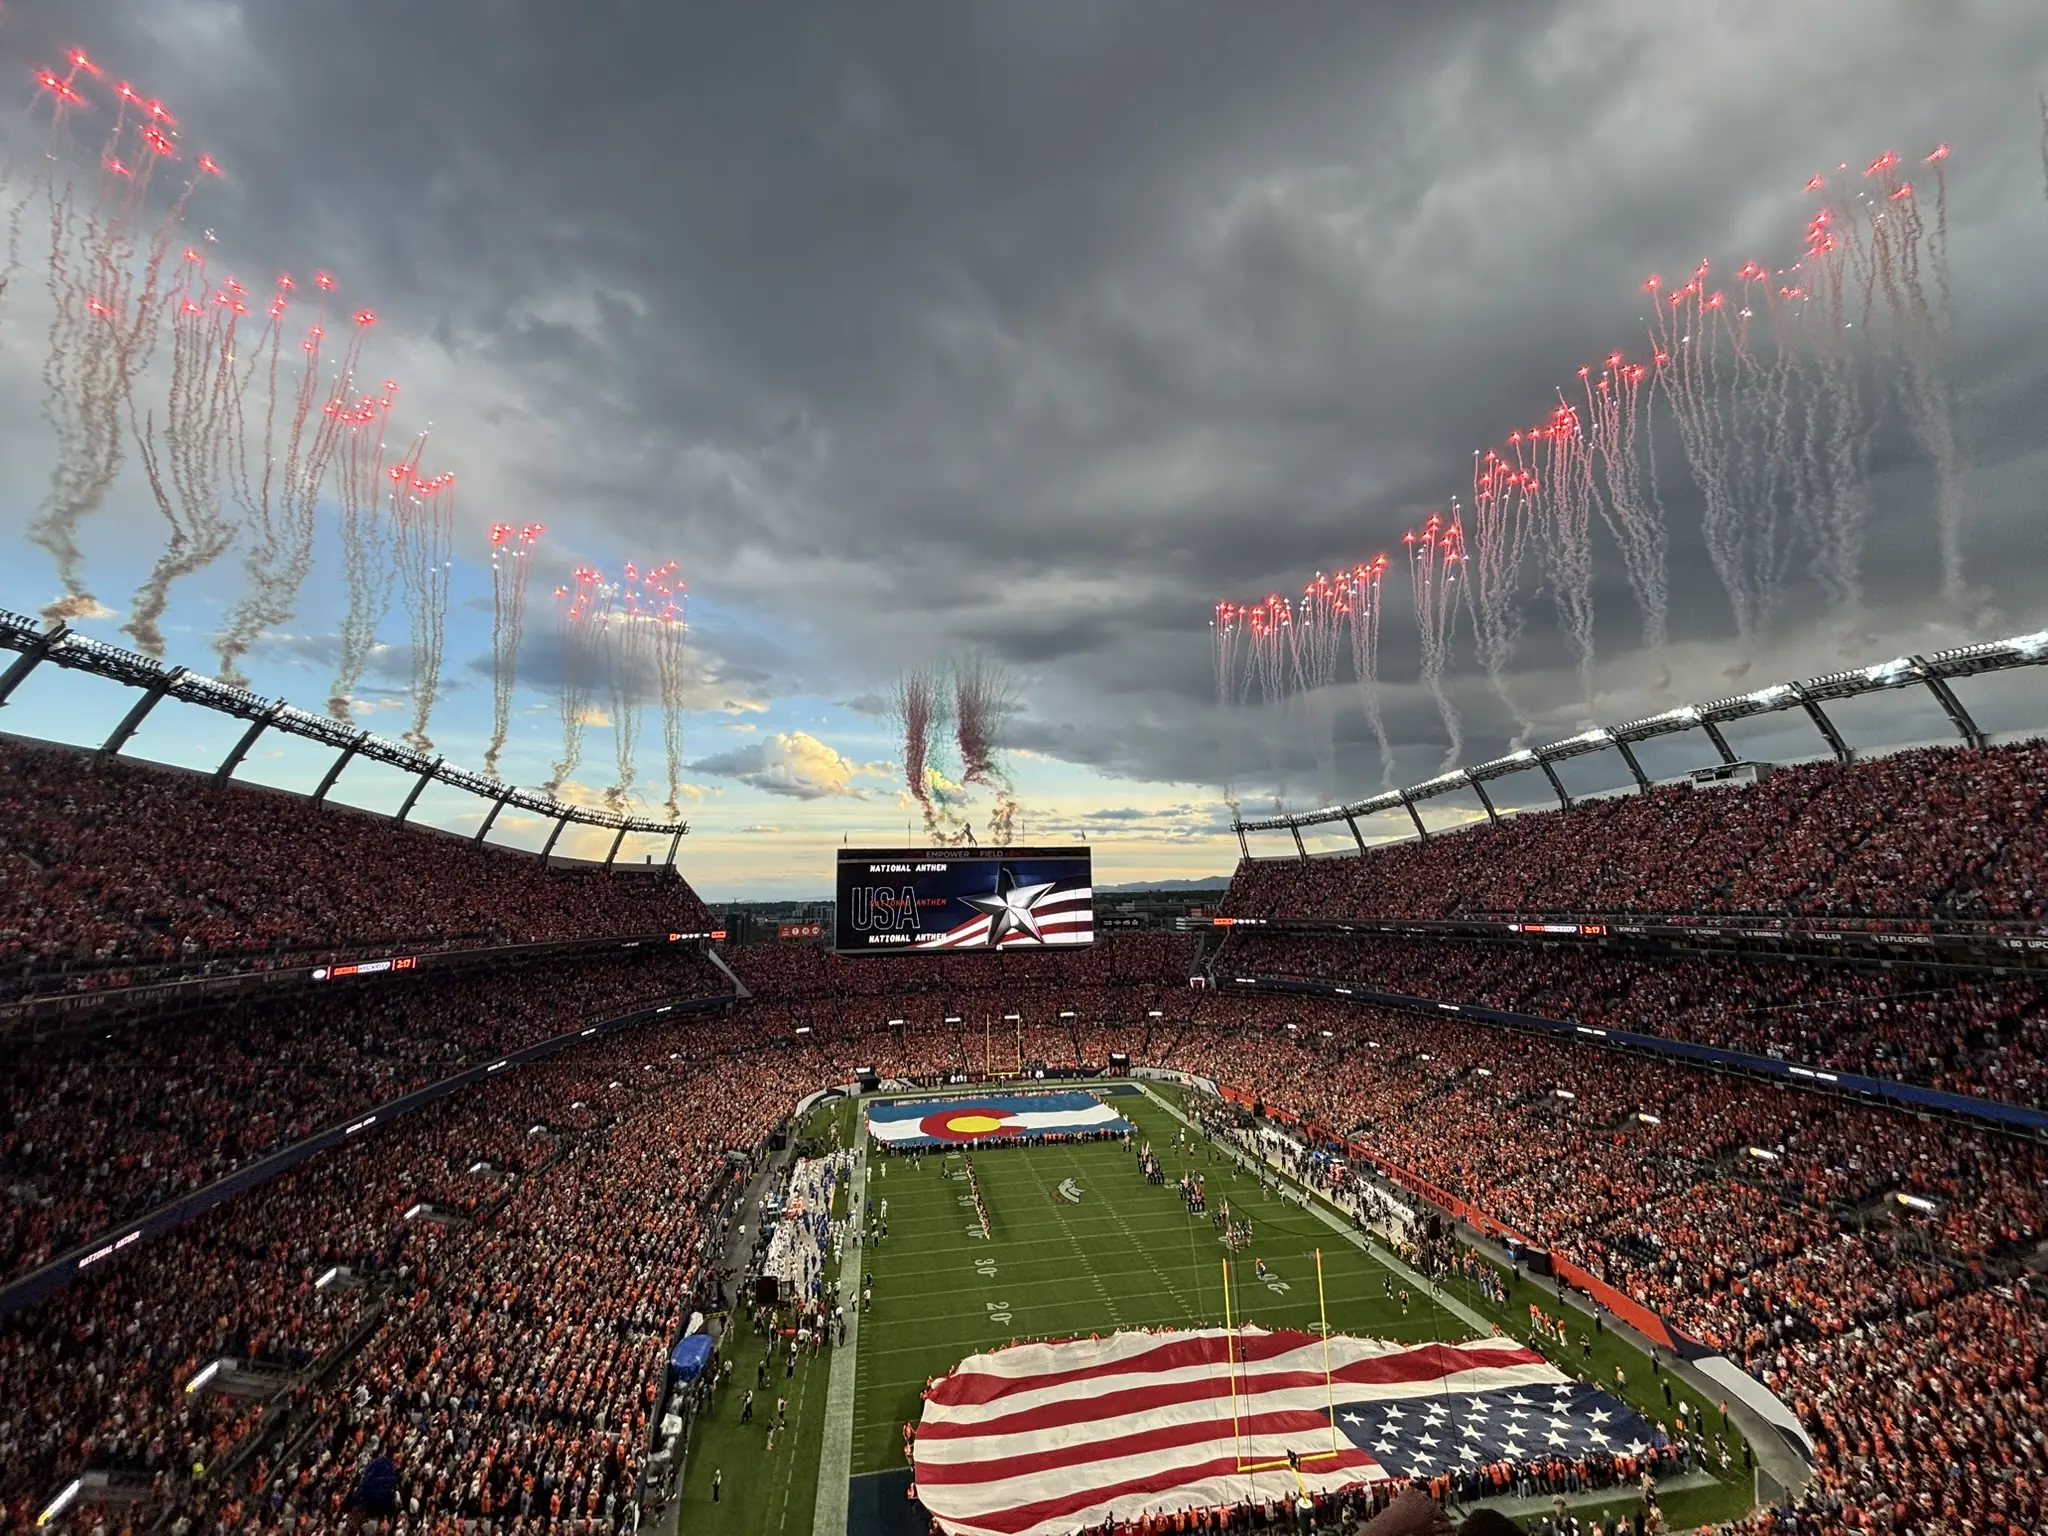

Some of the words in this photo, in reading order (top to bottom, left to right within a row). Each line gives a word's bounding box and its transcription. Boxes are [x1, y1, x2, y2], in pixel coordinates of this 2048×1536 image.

[926, 850, 970, 858] EMPOWER
[869, 864, 912, 873] NATIONAL
[915, 863, 947, 872] ANTHEM
[916, 898, 947, 906] ANTHEM
[852, 886, 921, 931] USA
[868, 933, 911, 943] NATIONAL
[915, 932, 948, 942] ANTHEM
[1889, 937, 1930, 945] FLETCHER
[396, 959, 412, 969] 2:17
[1397, 1171, 1454, 1212] BRONCOS
[974, 1258, 997, 1275] 30
[986, 1301, 1013, 1322] 20
